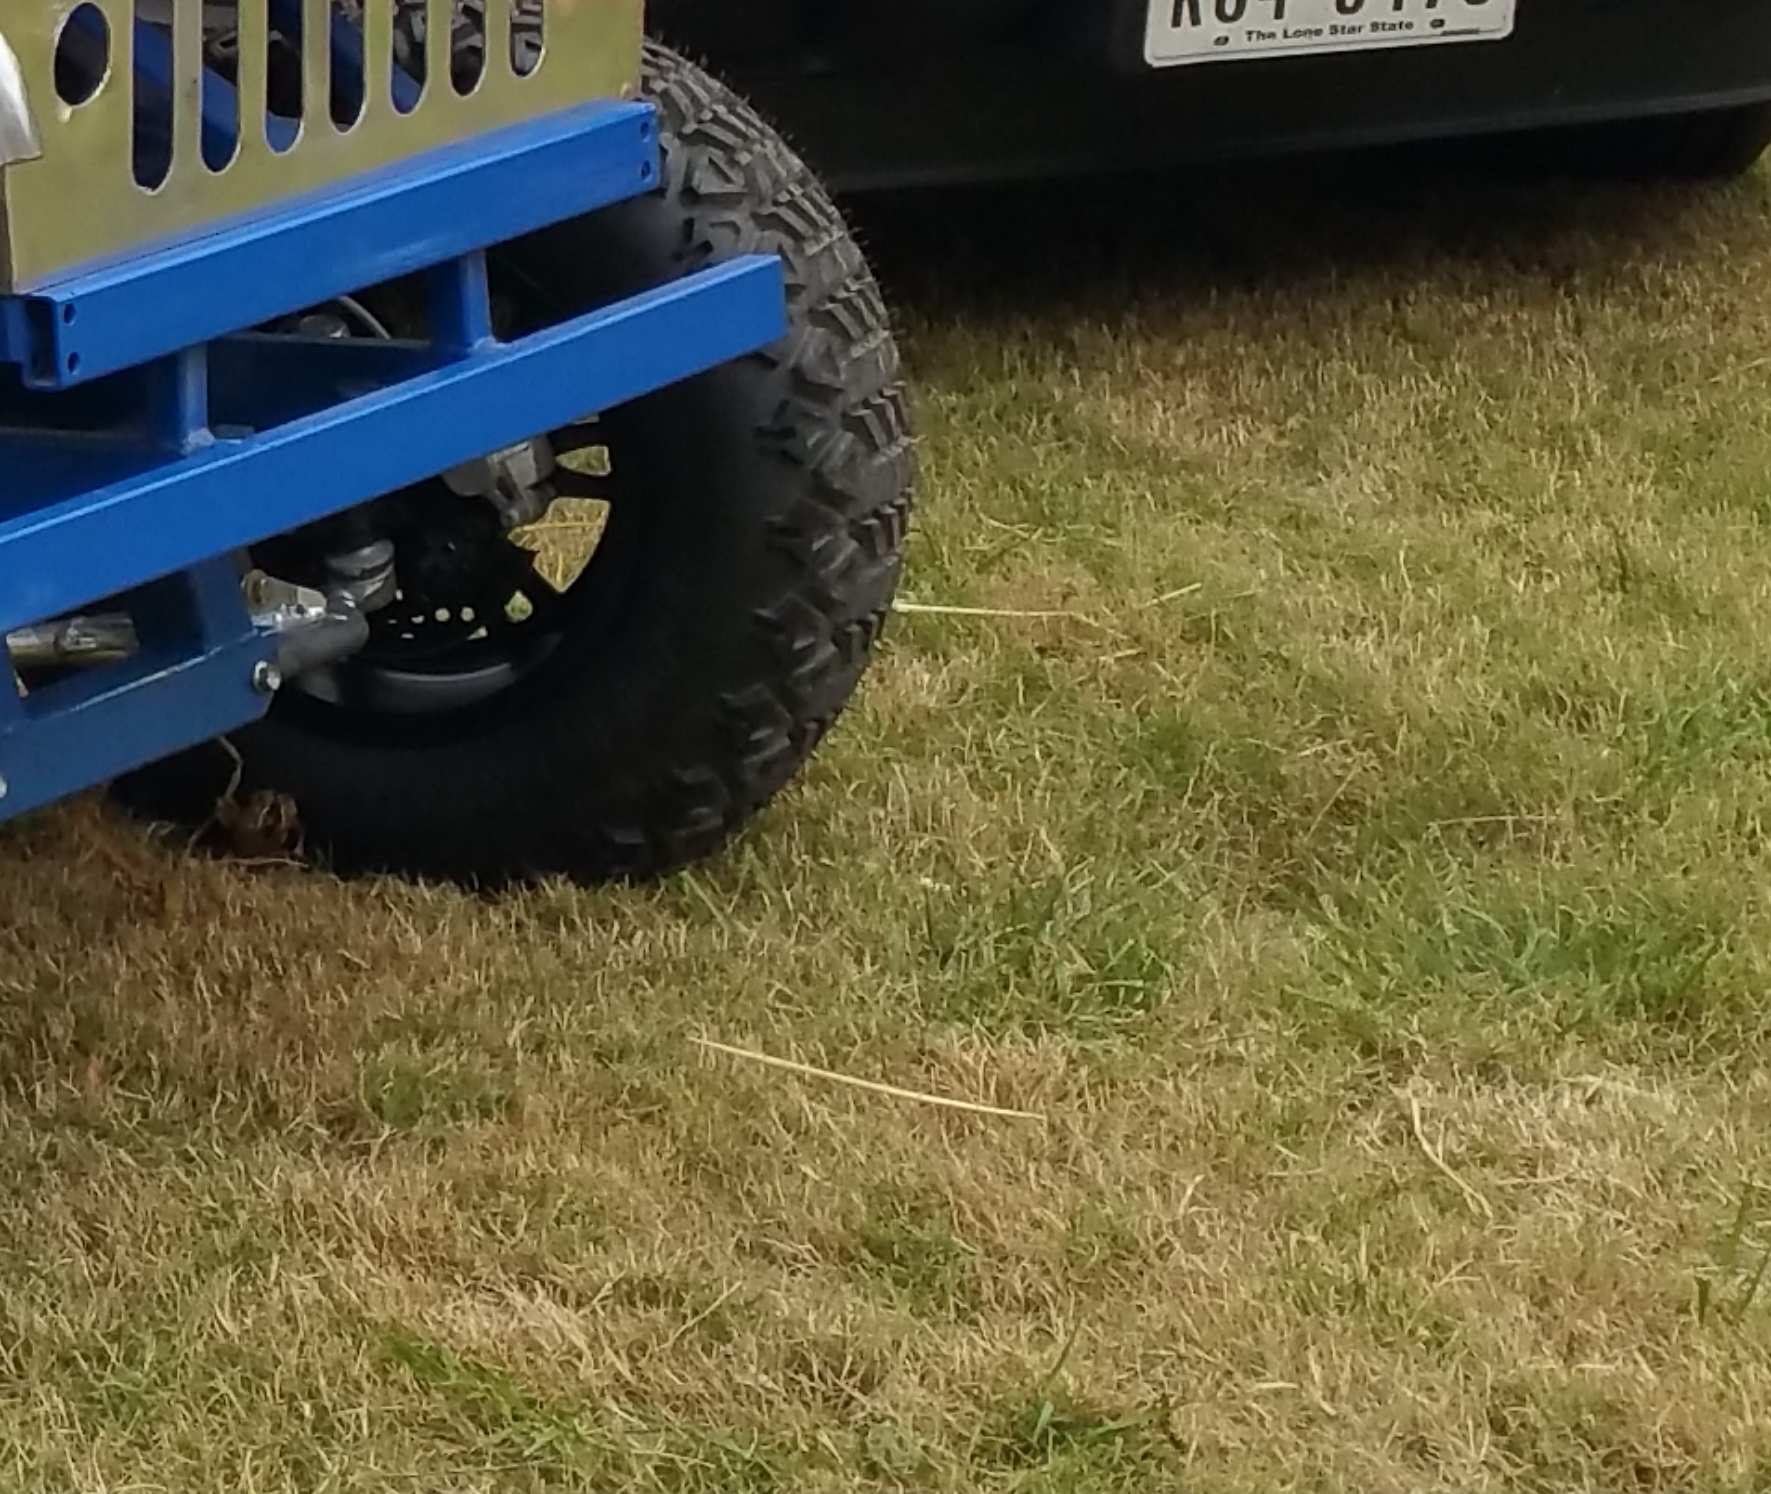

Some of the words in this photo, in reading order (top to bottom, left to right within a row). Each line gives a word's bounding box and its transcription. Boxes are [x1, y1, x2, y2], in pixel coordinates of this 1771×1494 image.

[1245, 29, 1277, 43] The
[1282, 25, 1324, 40] Lone
[1329, 22, 1363, 37] Star
[1369, 18, 1415, 34] State
